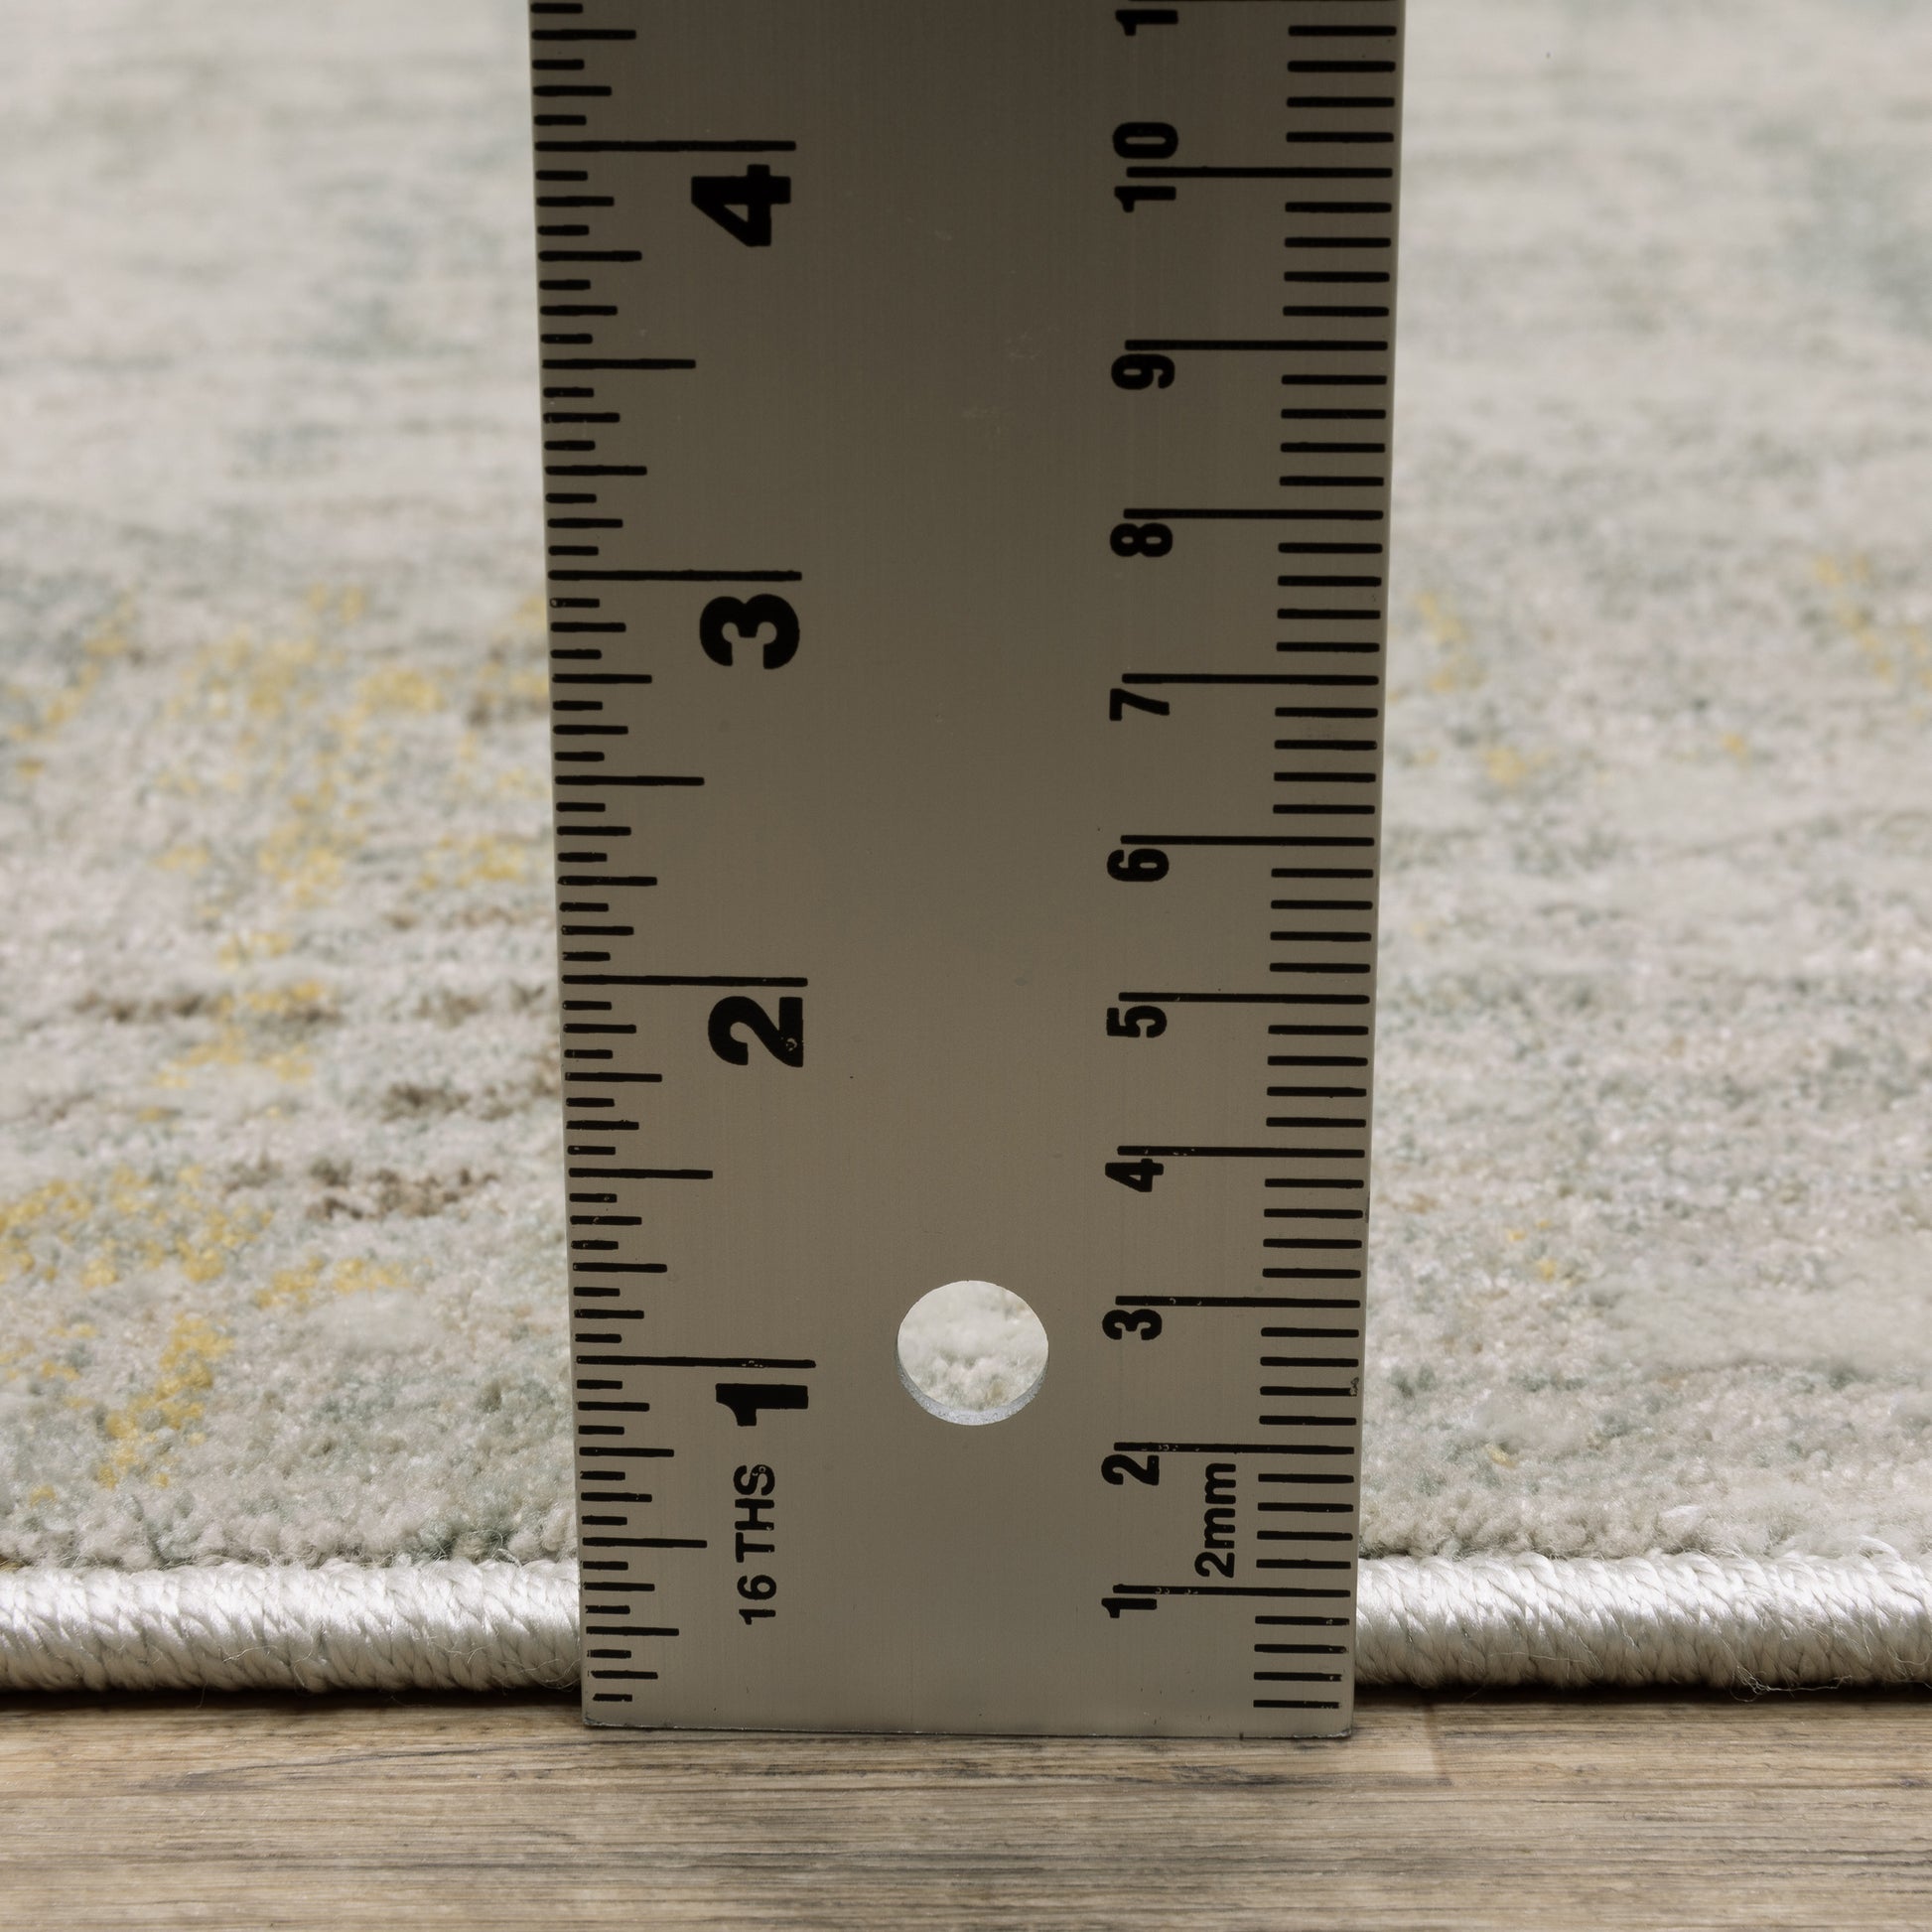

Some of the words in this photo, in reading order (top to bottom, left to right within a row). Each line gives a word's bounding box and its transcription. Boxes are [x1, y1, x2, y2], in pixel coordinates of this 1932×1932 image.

[1112, 121, 1179, 213] 10
[690, 163, 792, 248] 4
[1110, 352, 1176, 390] 9
[1109, 522, 1173, 558] 8
[699, 593, 801, 670] 3
[1109, 688, 1171, 722] 7
[1107, 848, 1169, 883] 6
[707, 996, 804, 1068] 2
[1106, 1005, 1167, 1038] 5
[1104, 1158, 1165, 1193] 4
[1102, 1309, 1163, 1341] 3
[715, 1382, 809, 1428] 1
[1100, 1453, 1161, 1486] 2
[733, 1463, 775, 1564] THS
[1193, 1462, 1237, 1579] 2mm
[737, 1575, 777, 1626] 16
[1100, 1596, 1158, 1619] 1
